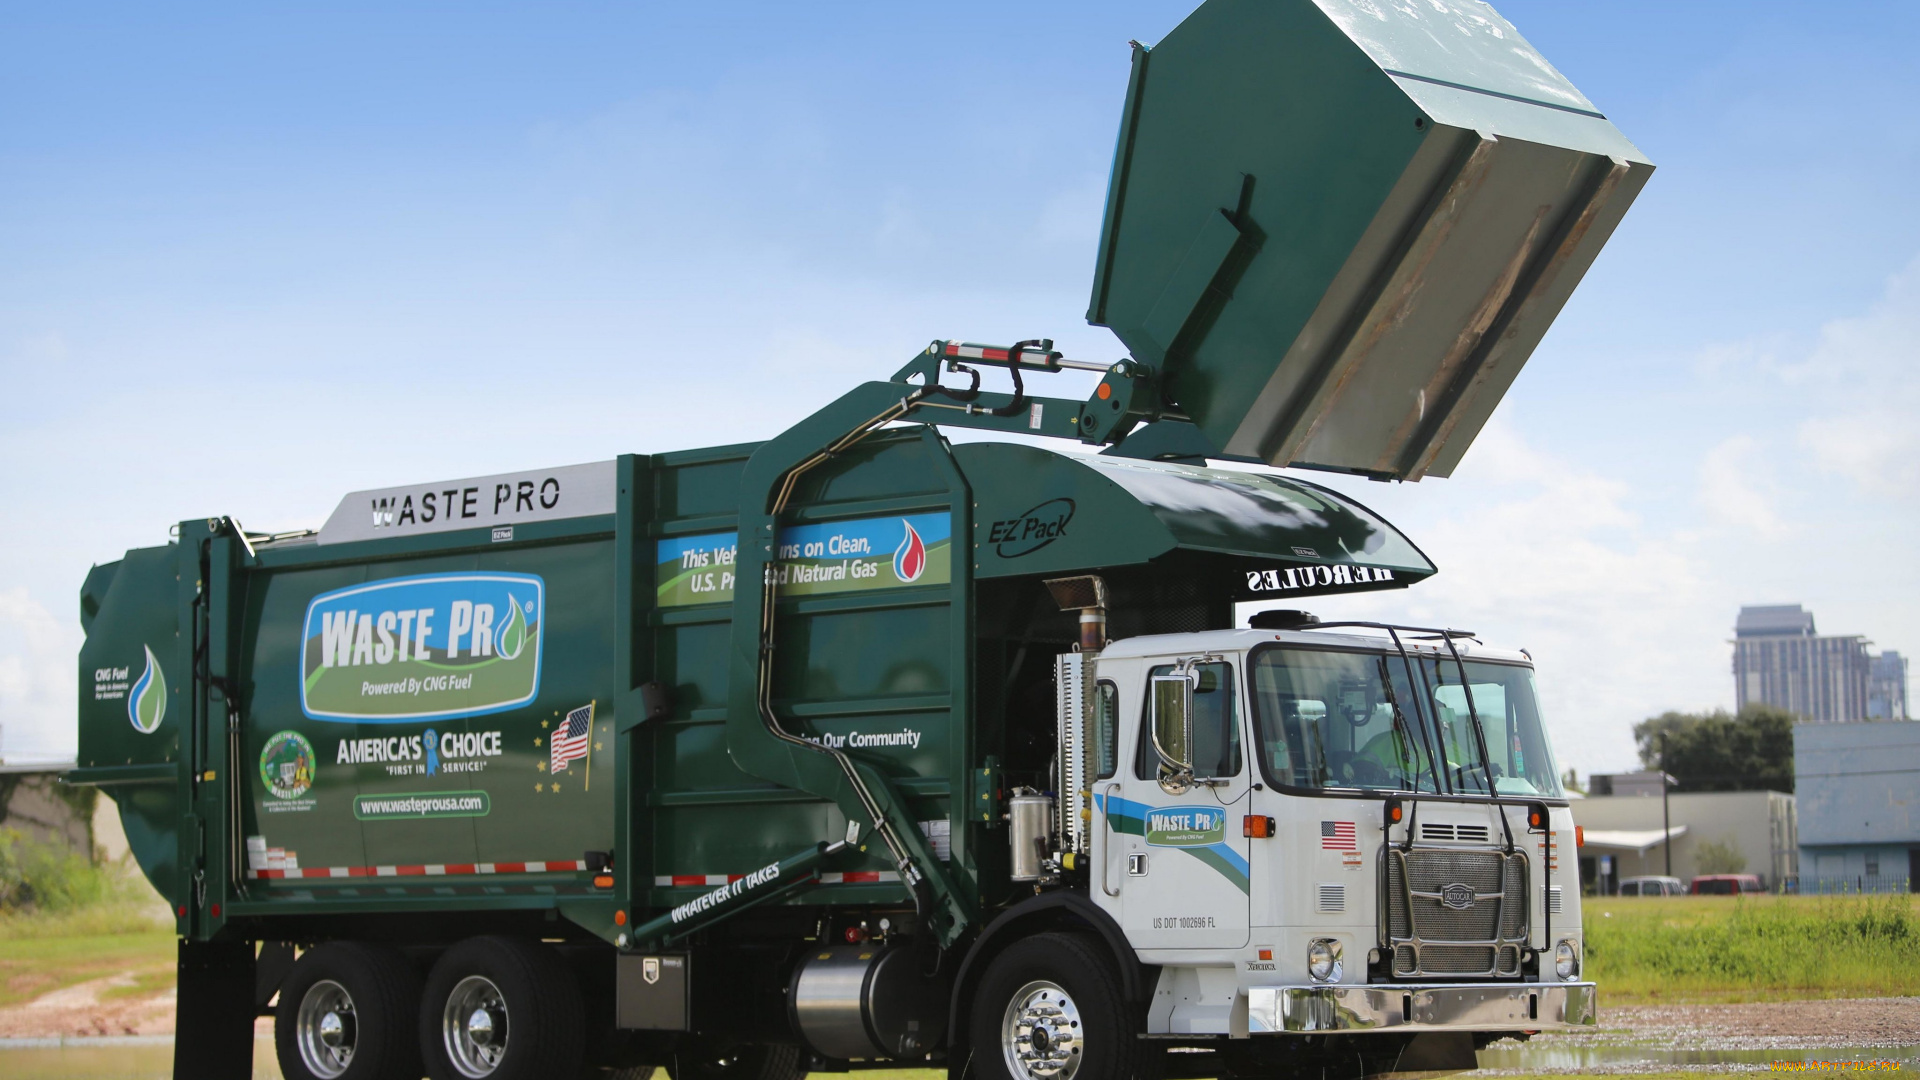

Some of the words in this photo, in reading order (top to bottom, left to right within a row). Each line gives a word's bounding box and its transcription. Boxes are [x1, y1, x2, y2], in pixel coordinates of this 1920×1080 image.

[371, 487, 479, 529] WASTE
[494, 477, 560, 515] PRO
[1021, 515, 1067, 540] Pack
[682, 548, 709, 569] This
[804, 541, 823, 556] on
[828, 534, 871, 555] Clean,
[690, 572, 716, 592] U.S.
[792, 560, 847, 583] Natural
[850, 559, 878, 579] Gas
[322, 608, 434, 667] WASTE
[95, 668, 112, 682] CNG
[112, 665, 129, 680] Fuel
[361, 677, 406, 696] Powered
[407, 677, 422, 696] By
[423, 675, 447, 692] CNG
[449, 673, 473, 690] Fuel
[283, 732, 293, 740] THE
[823, 732, 846, 748] Our
[848, 728, 921, 749] Community
[336, 735, 422, 764] AMERICA'S
[440, 731, 502, 758] CHOICE
[415, 764, 425, 774] IN
[361, 796, 482, 815] www.wasteprousa.com
[1151, 814, 1190, 832] WASTE
[671, 884, 731, 923] WHATEVER
[732, 877, 744, 896] IT
[745, 861, 780, 889] TAKES
[1445, 892, 1471, 901] AUTOCAR
[1153, 917, 1163, 929] US
[1164, 917, 1177, 928] DOT
[1179, 917, 1206, 928] 1002696
[1207, 916, 1216, 928] FL
